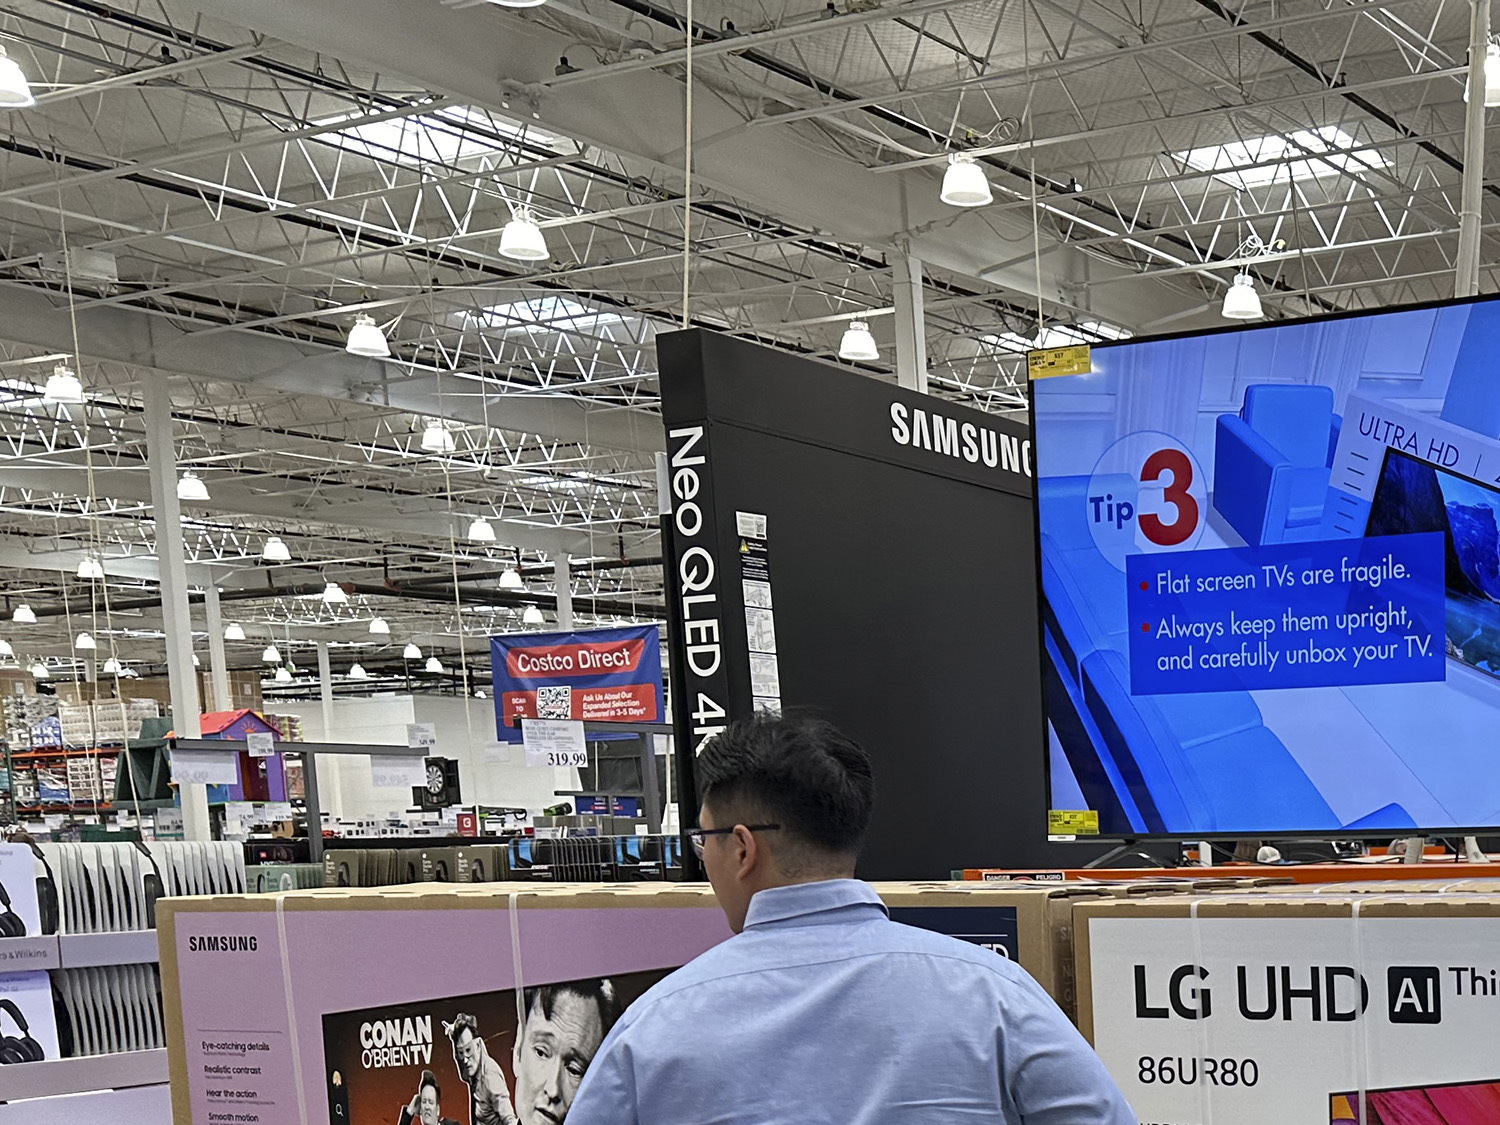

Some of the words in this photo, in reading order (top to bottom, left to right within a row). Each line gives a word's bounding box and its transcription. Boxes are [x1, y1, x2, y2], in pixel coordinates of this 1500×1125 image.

[1358, 412, 1418, 456] ULTRA
[1426, 437, 1460, 468] HD
[668, 426, 705, 537] Neo
[1089, 494, 1135, 530] Tip
[1137, 448, 1199, 546] 3
[1156, 570, 1190, 595] Flat
[1196, 572, 1256, 593] screen
[1261, 564, 1295, 588] TVs
[1301, 567, 1334, 586] are
[1341, 553, 1411, 588] fragile.
[679, 546, 722, 678] QLED
[1156, 614, 1224, 644] Always
[1230, 610, 1276, 641] keep
[1282, 607, 1329, 632] them
[1335, 600, 1413, 636] upright,
[517, 653, 574, 672] Costco
[577, 648, 631, 670] Direct
[1157, 645, 1193, 671] and
[1199, 640, 1280, 672] carefully
[1285, 638, 1347, 665] unbox
[1352, 641, 1398, 668] your
[1403, 634, 1433, 659] TV.
[547, 752, 587, 766] 319.99
[189, 936, 258, 952] SAMSUNG
[1134, 964, 1212, 1020] LG
[1236, 964, 1369, 1023] UHD
[1394, 977, 1437, 1015] AI
[202, 1041, 247, 1054] Eye-catching
[247, 1042, 271, 1052] details
[360, 1015, 433, 1050] CONAN
[204, 1065, 231, 1075] Realistic
[232, 1066, 261, 1075] contrast
[1137, 1055, 1260, 1088] 86UR80
[206, 1089, 222, 1098] Hear
[223, 1089, 234, 1098] the
[235, 1090, 257, 1098] action
[208, 1112, 234, 1121] Smooth
[235, 1113, 259, 1123] motion
